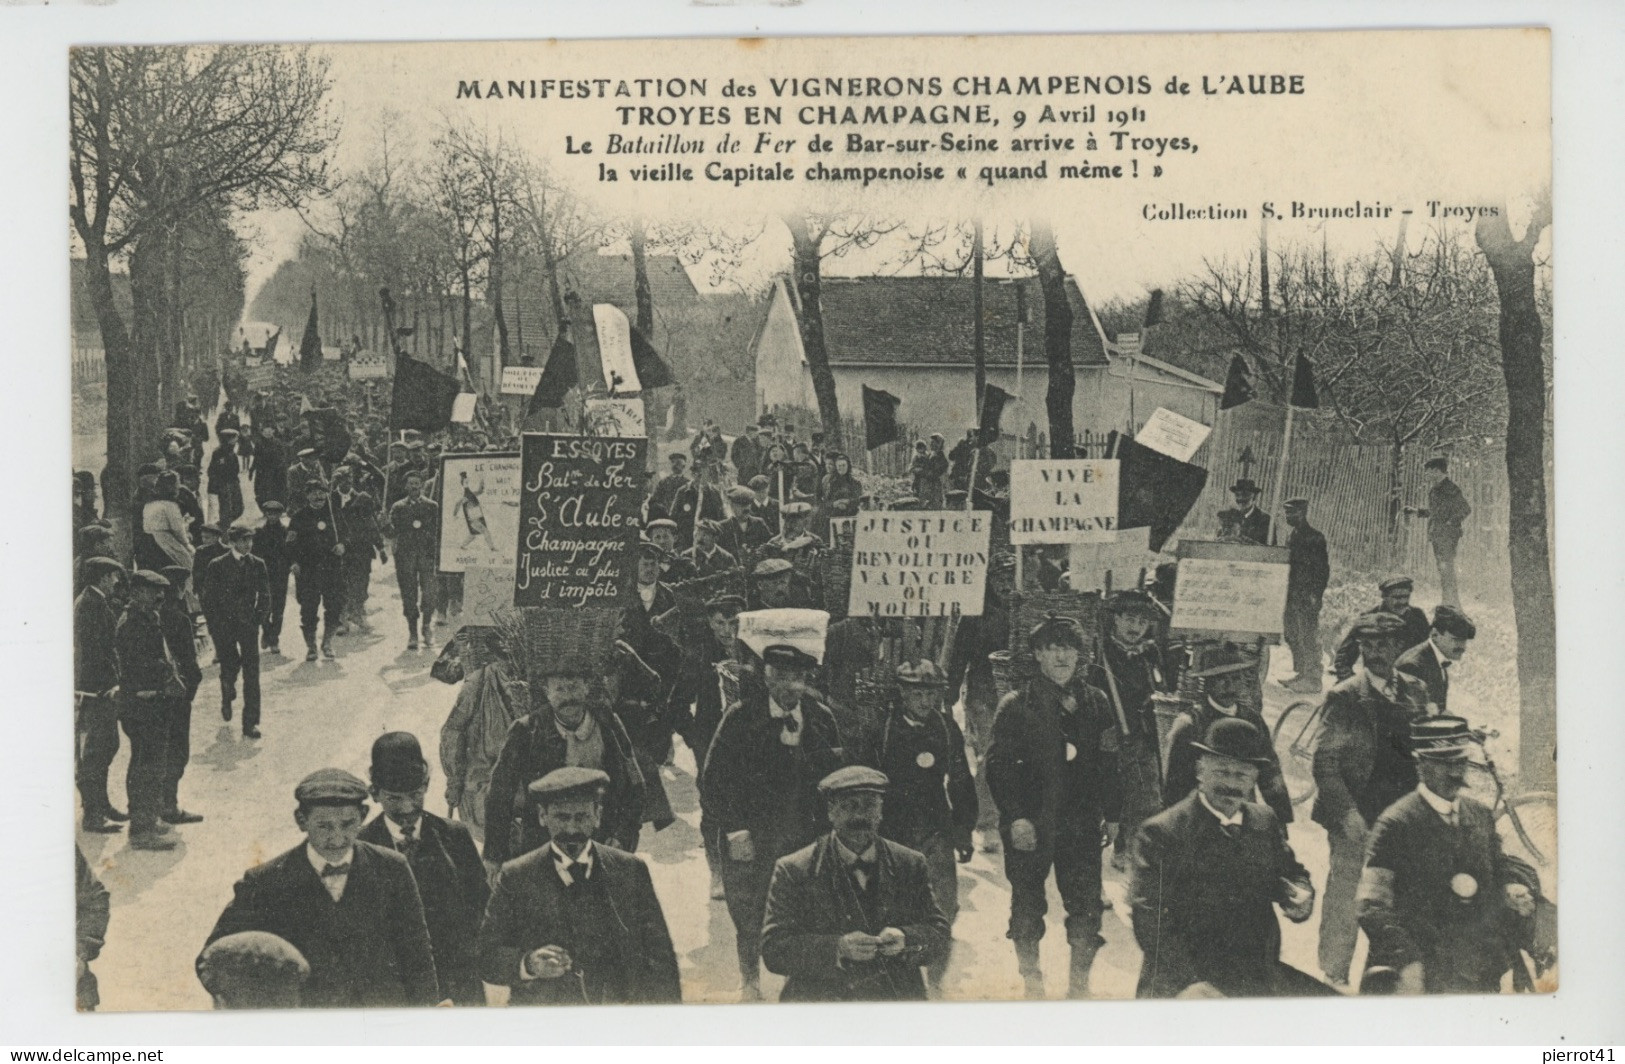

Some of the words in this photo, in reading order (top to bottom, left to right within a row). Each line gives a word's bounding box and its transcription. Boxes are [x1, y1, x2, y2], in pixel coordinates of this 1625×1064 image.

[455, 77, 707, 100] MANIFESTATION
[721, 78, 757, 98] des
[769, 76, 943, 98] VIGNERONS
[952, 75, 1152, 97] CHAMPENOIS
[1164, 75, 1191, 96] de
[1202, 74, 1305, 96] L'AUBE
[615, 106, 731, 126] TROYES
[744, 106, 782, 126] EN
[798, 104, 1000, 127] CHAMPAGNE,
[1012, 110, 1027, 128] 9
[1038, 104, 1096, 124] Avril
[1107, 106, 1146, 128] 1911
[565, 135, 593, 155] Le
[606, 133, 705, 155] Bataillon
[716, 132, 741, 154] de
[753, 131, 797, 154] Fer
[807, 133, 834, 154] de
[845, 131, 999, 153] Bar-sur-Seine
[1010, 133, 1075, 152] arrive
[1086, 131, 1098, 151] à
[1109, 130, 1199, 158] Troyes,
[598, 162, 618, 182] la
[629, 162, 694, 182] vieille
[704, 161, 795, 187] Capitale
[805, 161, 945, 187] champenoise
[978, 159, 1048, 187] quand
[1131, 159, 1139, 179] !
[1142, 202, 1248, 221] Collection
[1261, 201, 1283, 221] S.
[1291, 200, 1393, 219] Brunclair
[1426, 200, 1499, 224] Troyes
[551, 440, 637, 459] ESSOYES
[584, 476, 600, 487] de
[603, 461, 637, 488] Fer
[1056, 491, 1081, 505] LA
[626, 516, 640, 527] en
[863, 518, 982, 533] JUSTICE
[1011, 517, 1115, 532] CHAMPAGNE
[526, 530, 626, 566] Champagne
[907, 535, 937, 549] OU
[857, 551, 986, 567] REVOLUTION
[518, 553, 569, 590] Justice
[576, 568, 589, 576] ou
[590, 560, 620, 584] plus
[860, 570, 973, 585] VAINCRE
[903, 586, 932, 600] OU
[867, 601, 961, 616] MOURIR
